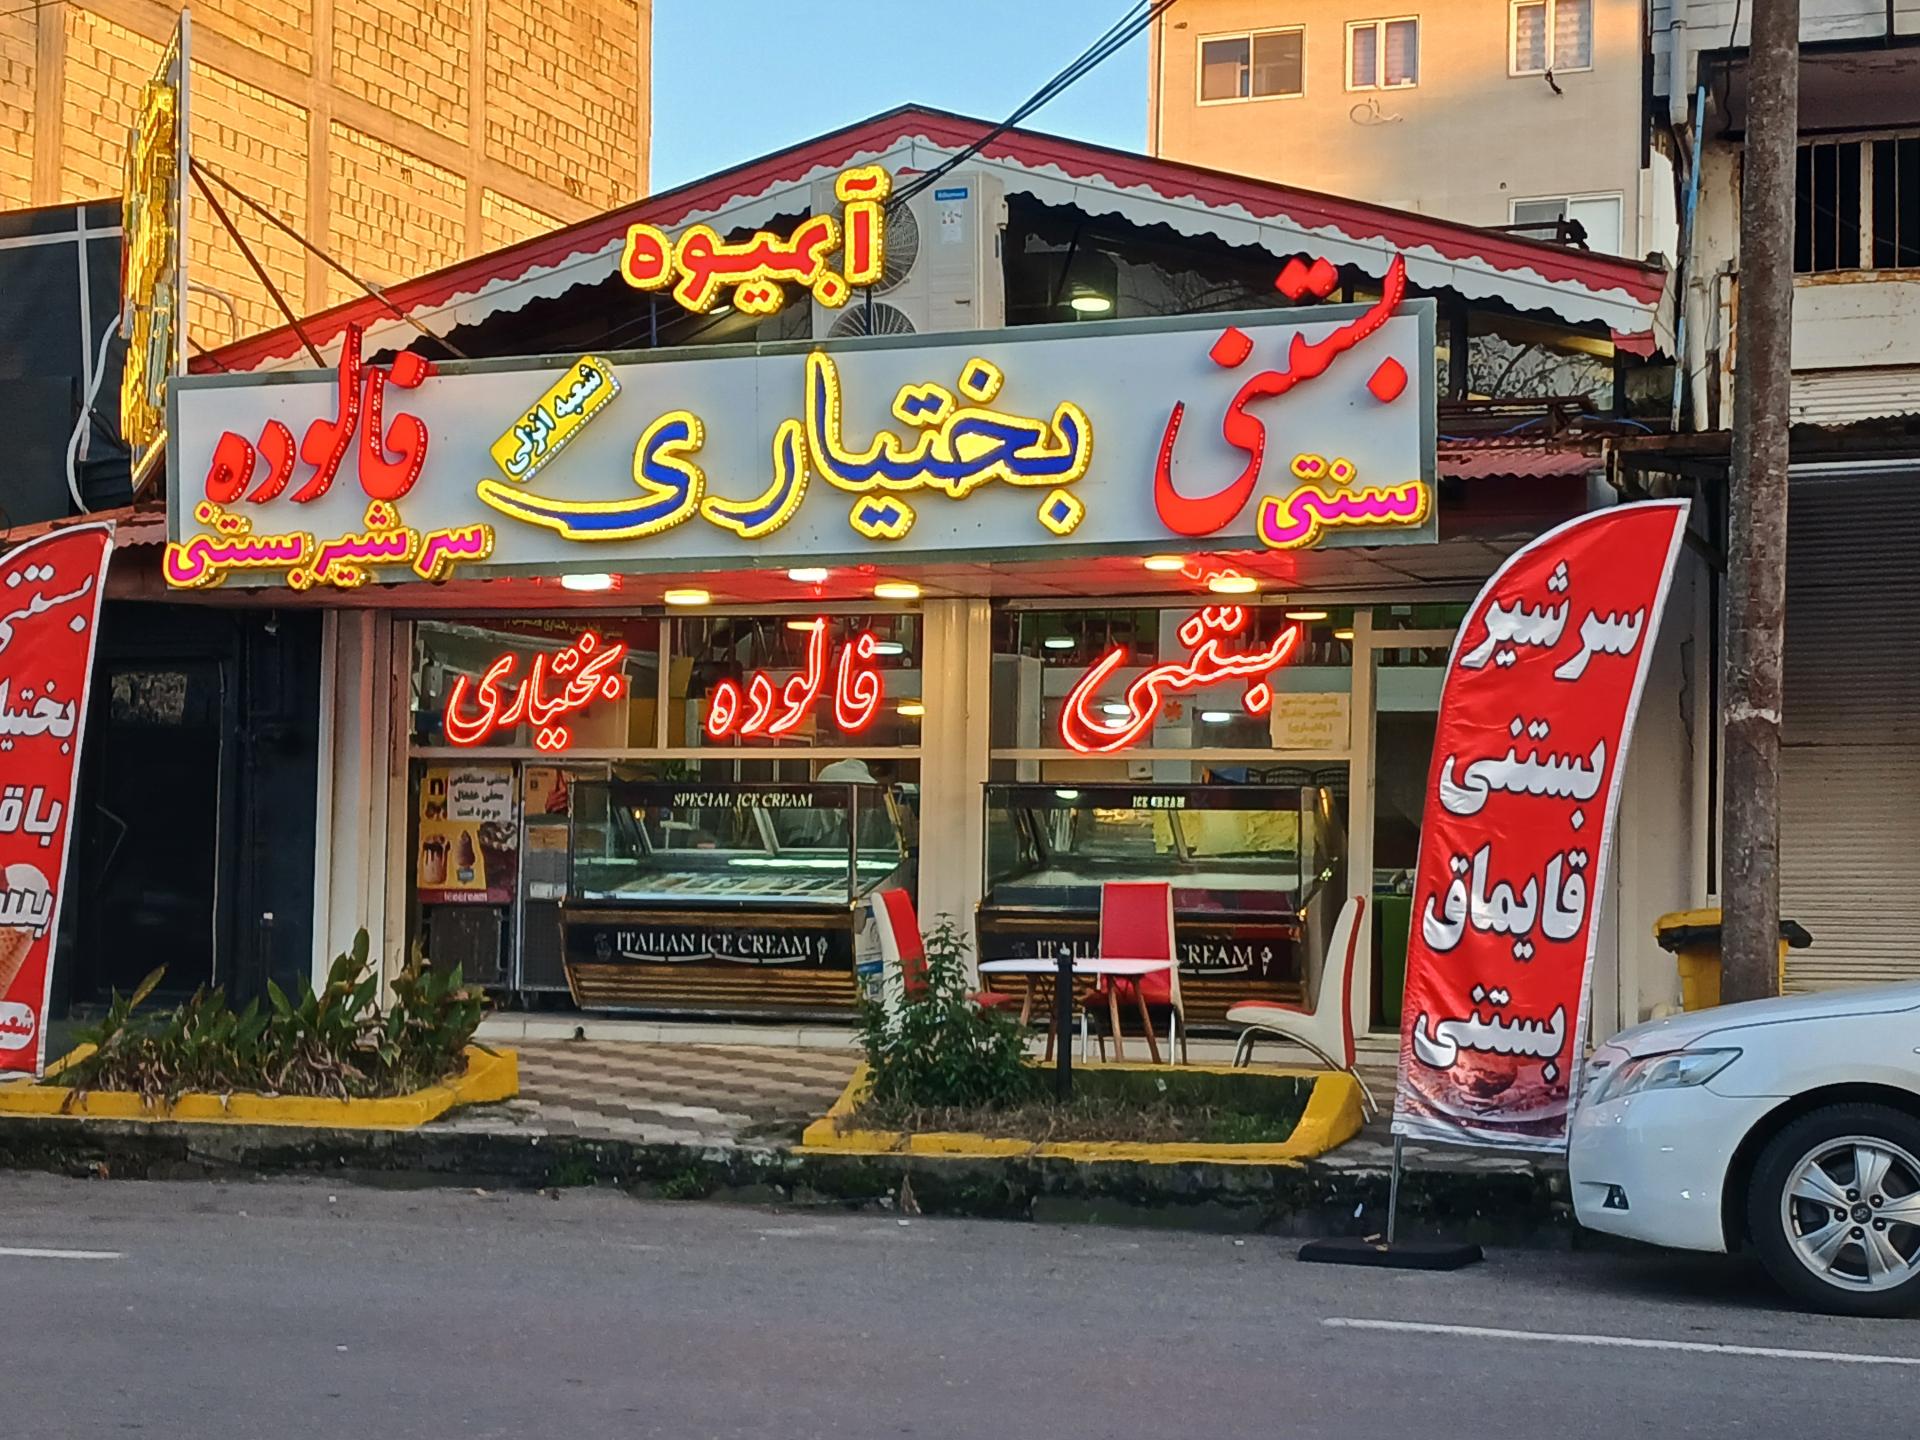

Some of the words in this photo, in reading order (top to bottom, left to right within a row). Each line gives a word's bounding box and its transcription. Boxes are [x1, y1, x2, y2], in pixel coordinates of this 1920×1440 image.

[621, 165, 892, 315] آبمیوه
[205, 322, 432, 503] فالوده
[476, 347, 1093, 541] بختیاری
[505, 404, 556, 476] انزلی
[554, 364, 603, 418] شعبه
[1154, 252, 1409, 536] بستنی
[164, 501, 315, 590] بستنی
[1256, 453, 1432, 549] سنتی
[447, 632, 623, 749] بختیاری
[709, 617, 879, 735] فالوده
[1062, 605, 1297, 751] بستنی
[673, 792, 732, 808] SPECIAL
[737, 792, 759, 808] ICE
[761, 792, 813, 808] CREAM
[1440, 717, 1606, 831] بستنی
[617, 931, 695, 953] ITALIAN
[701, 933, 732, 953] ICE
[738, 935, 811, 956] CREAM
[1182, 944, 1253, 967] REAM
[1422, 844, 1588, 959] قایماق
[1414, 983, 1567, 1081] بستنی
